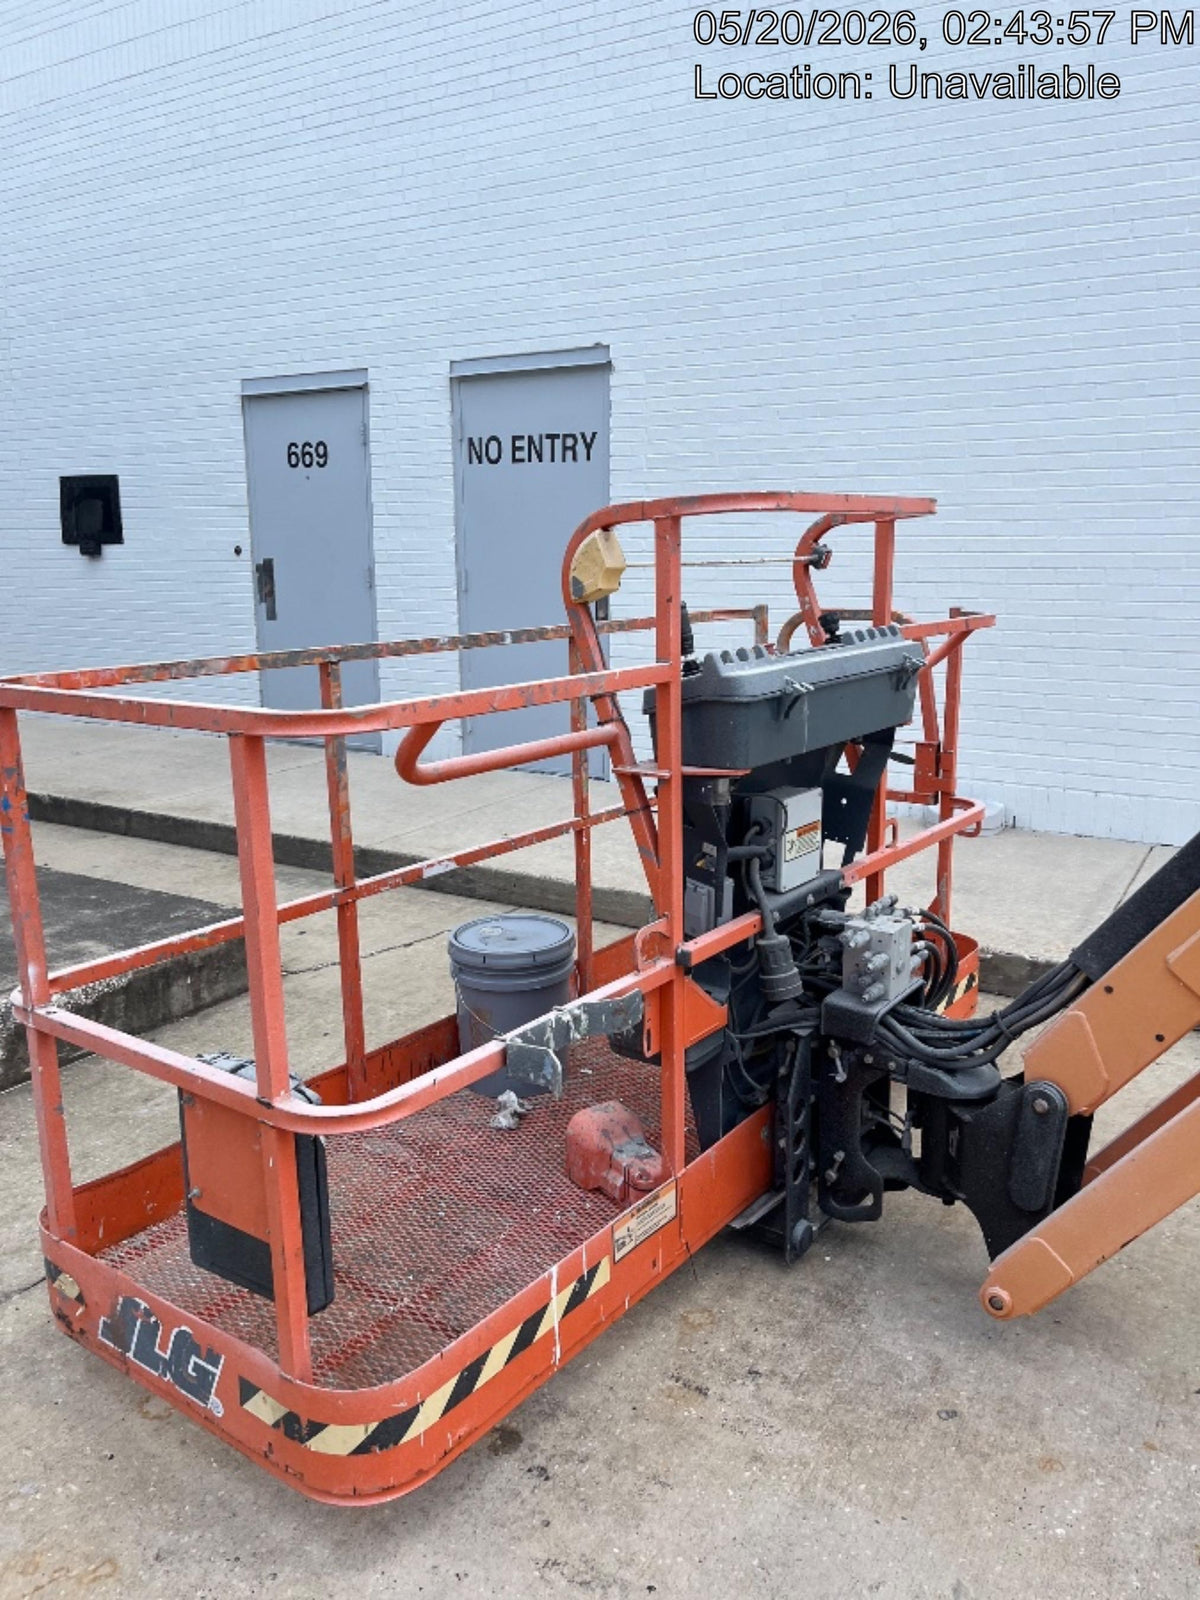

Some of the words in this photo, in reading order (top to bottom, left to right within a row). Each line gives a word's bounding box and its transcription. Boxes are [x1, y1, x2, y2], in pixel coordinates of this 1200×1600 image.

[286, 440, 329, 468] 669
[467, 434, 502, 465] NO
[511, 431, 598, 464] ENTRY
[98, 1295, 225, 1409] JLG
